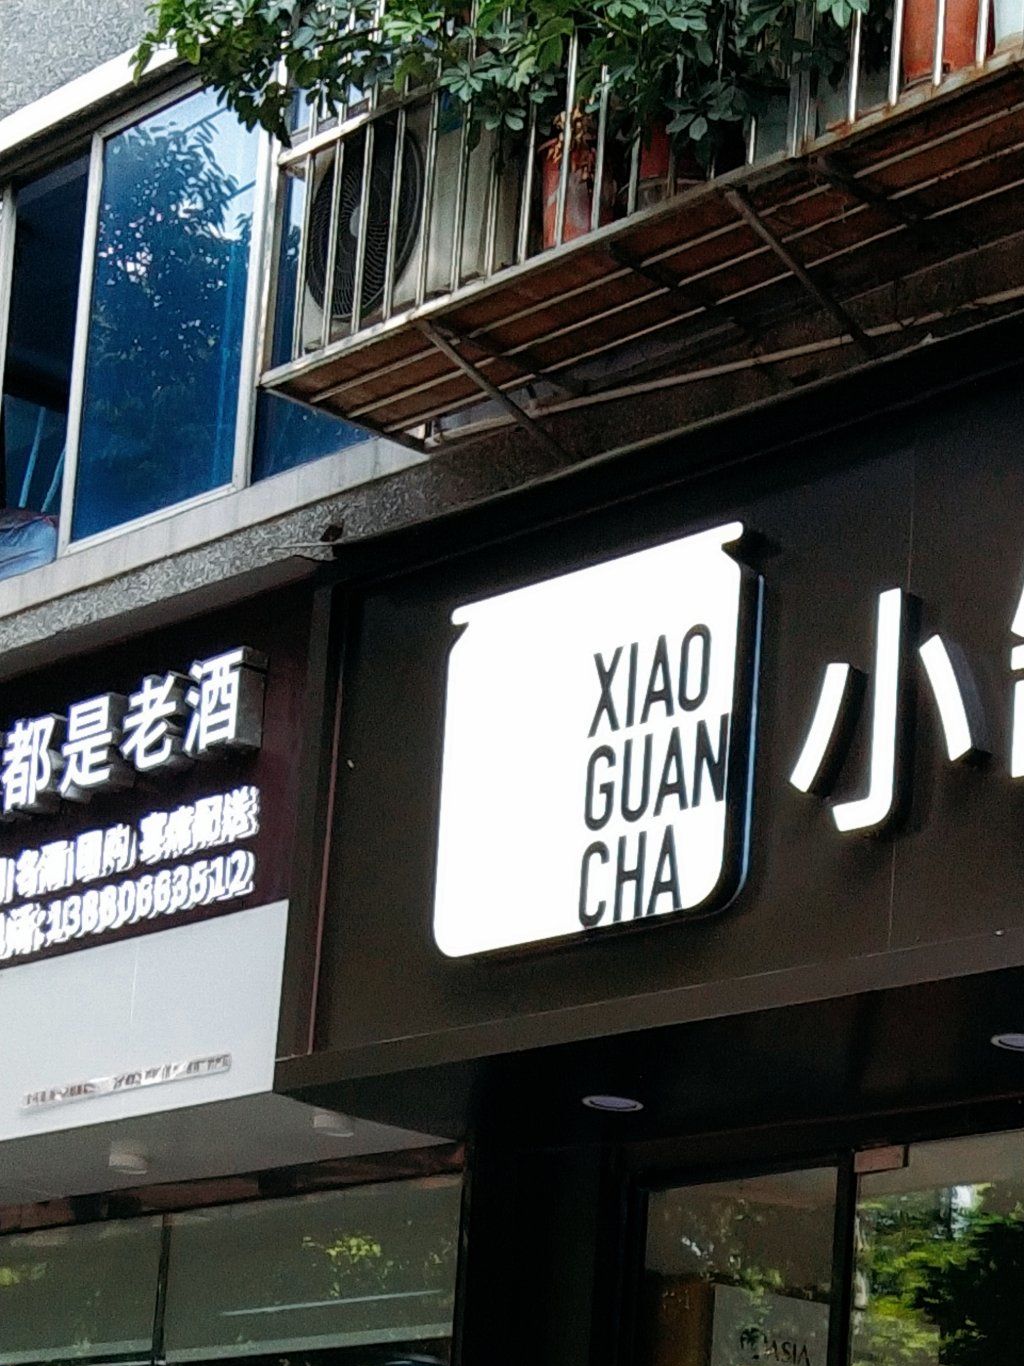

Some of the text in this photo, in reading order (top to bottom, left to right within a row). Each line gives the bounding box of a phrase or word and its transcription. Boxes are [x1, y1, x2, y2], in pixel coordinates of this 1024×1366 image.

[1, 648, 247, 817] 都是老酒
[587, 623, 712, 738] XIAO
[584, 712, 730, 832] GUAN
[578, 823, 683, 930] CHA
